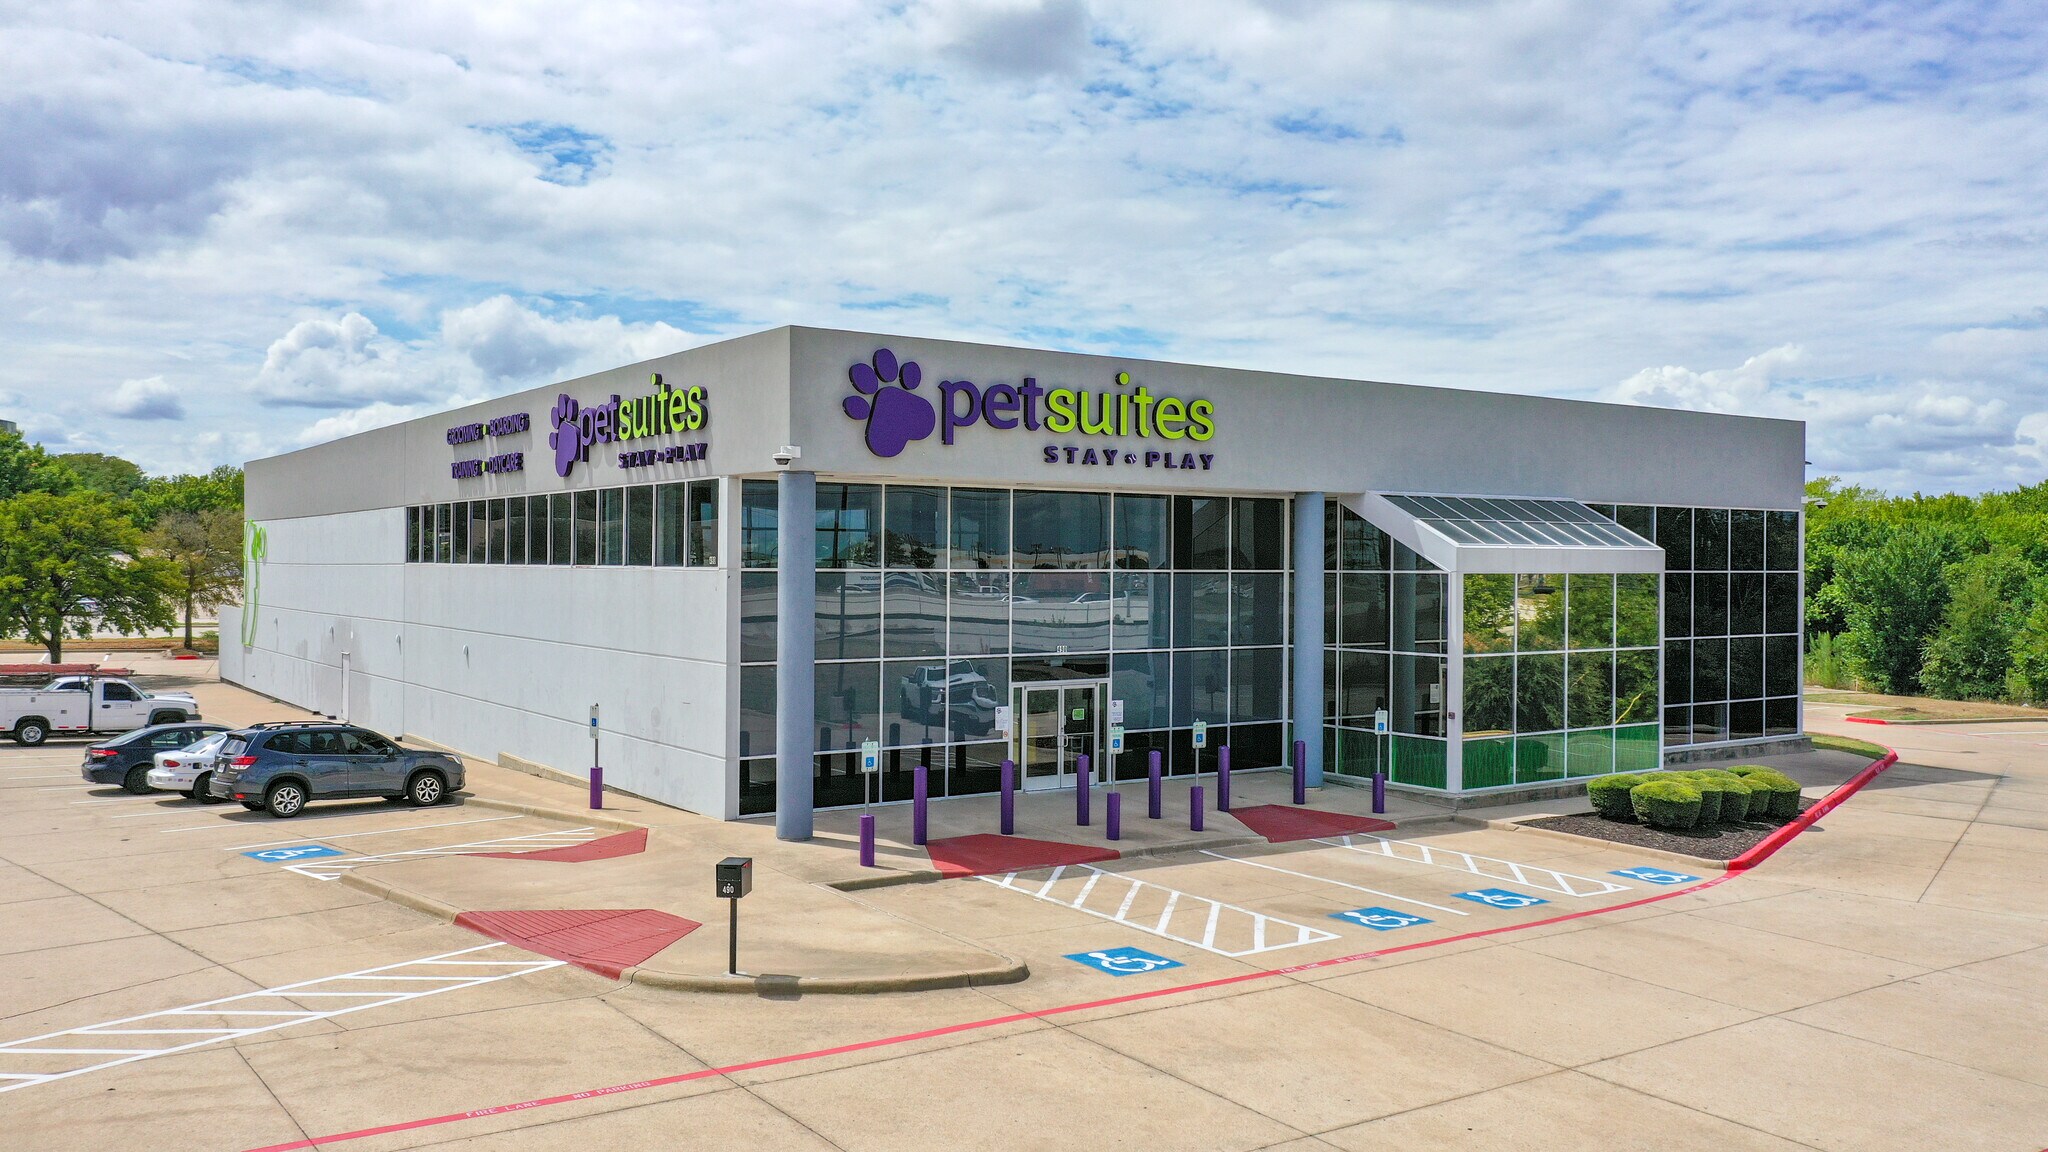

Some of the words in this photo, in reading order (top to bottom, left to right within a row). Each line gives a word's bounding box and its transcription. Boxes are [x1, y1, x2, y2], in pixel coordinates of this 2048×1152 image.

[579, 373, 708, 462] petsuites
[938, 371, 1215, 446] petsuites
[447, 423, 483, 445] GROOMING
[489, 412, 530, 437] BOARDING
[451, 459, 482, 479] TRAINING
[488, 452, 523, 475] DAYCARE
[618, 450, 656, 469] STAY
[665, 443, 708, 463] PLAY
[1043, 445, 1118, 466] STAY
[1145, 452, 1214, 470] PLAY
[465, 1107, 499, 1118] FIRE
[504, 1101, 541, 1112] LANE
[572, 1092, 591, 1100] NO
[596, 1081, 652, 1094] PARKING
